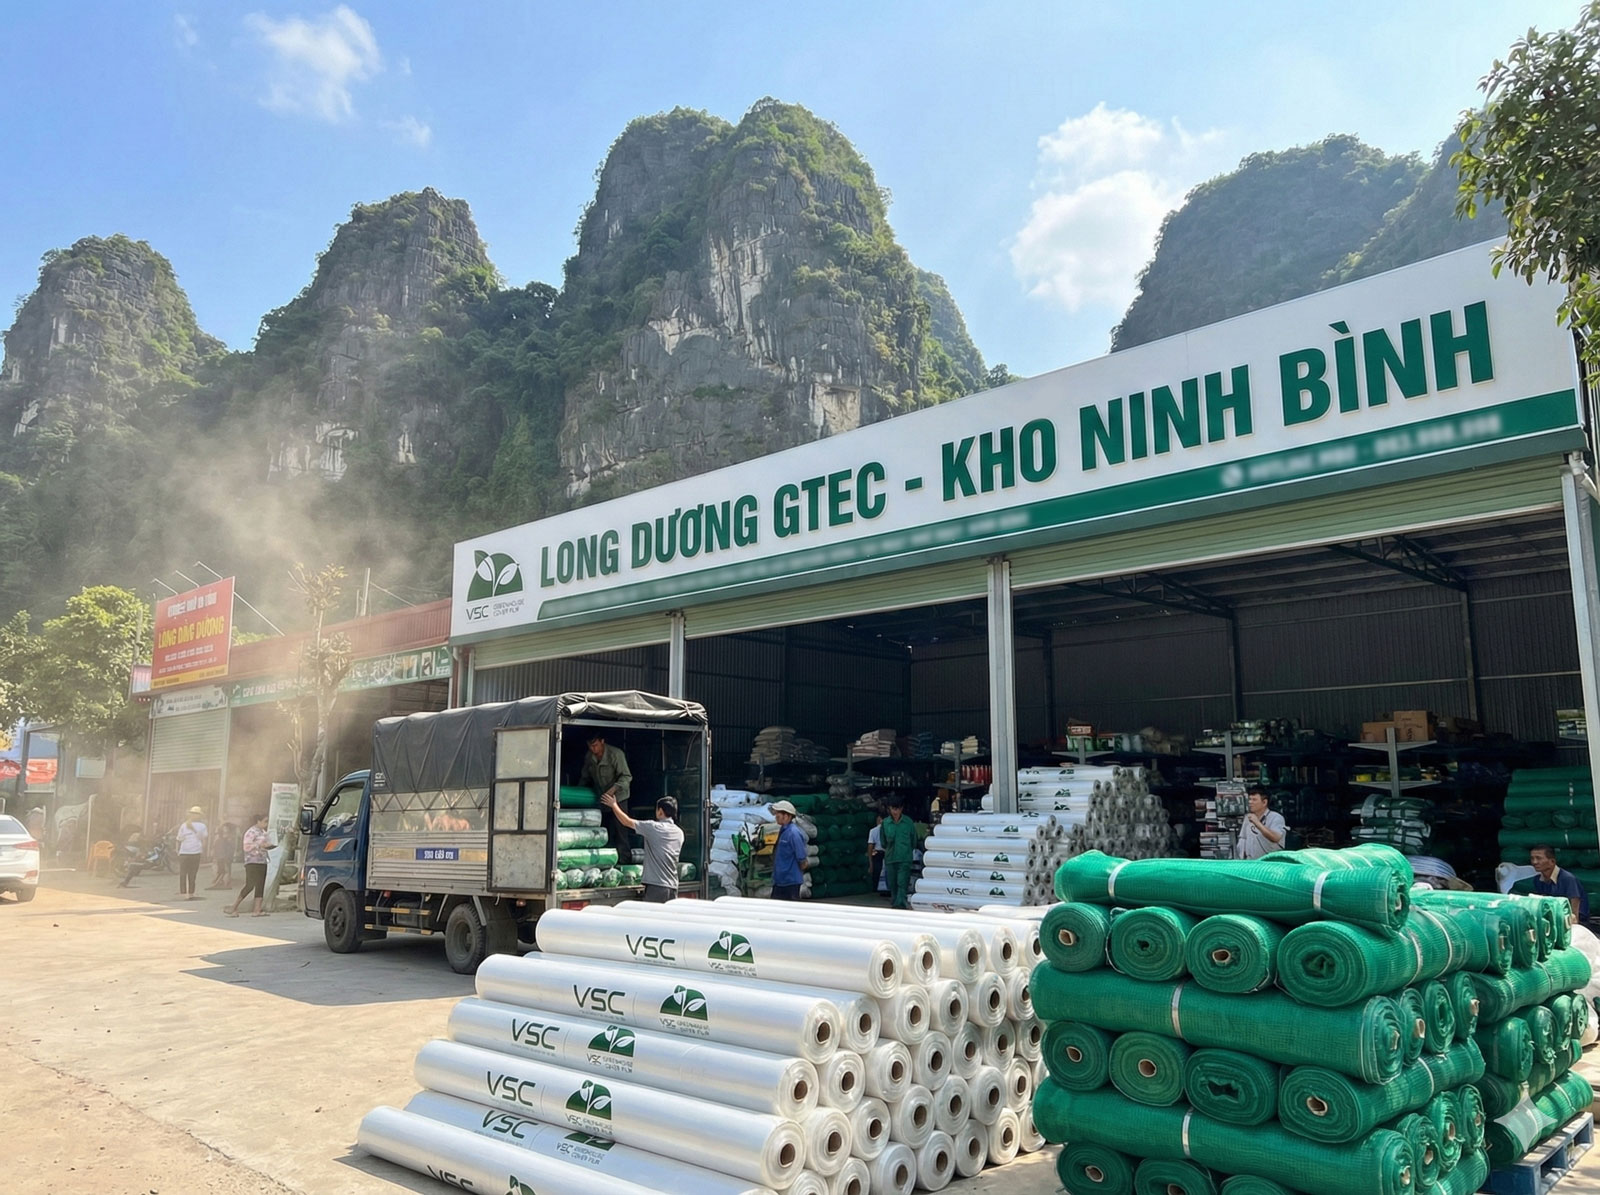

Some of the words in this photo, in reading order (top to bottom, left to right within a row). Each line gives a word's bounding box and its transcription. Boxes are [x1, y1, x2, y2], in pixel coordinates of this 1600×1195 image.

[540, 529, 619, 588] LONG
[631, 494, 758, 569] DƯƠNG
[773, 461, 886, 538] GTEC
[905, 476, 923, 492] -
[941, 418, 1056, 502] KHO
[1079, 364, 1253, 471] NINH
[1279, 301, 1494, 427] BÌNH
[466, 605, 489, 620] VSC
[952, 851, 976, 859] VSC
[947, 870, 970, 879] VSC
[946, 887, 970, 896] VSC
[625, 934, 675, 961] VSC
[573, 984, 626, 1016] VSC
[512, 1018, 560, 1050] VSC
[487, 1071, 536, 1106] VSC
[482, 1110, 539, 1139] VSC
